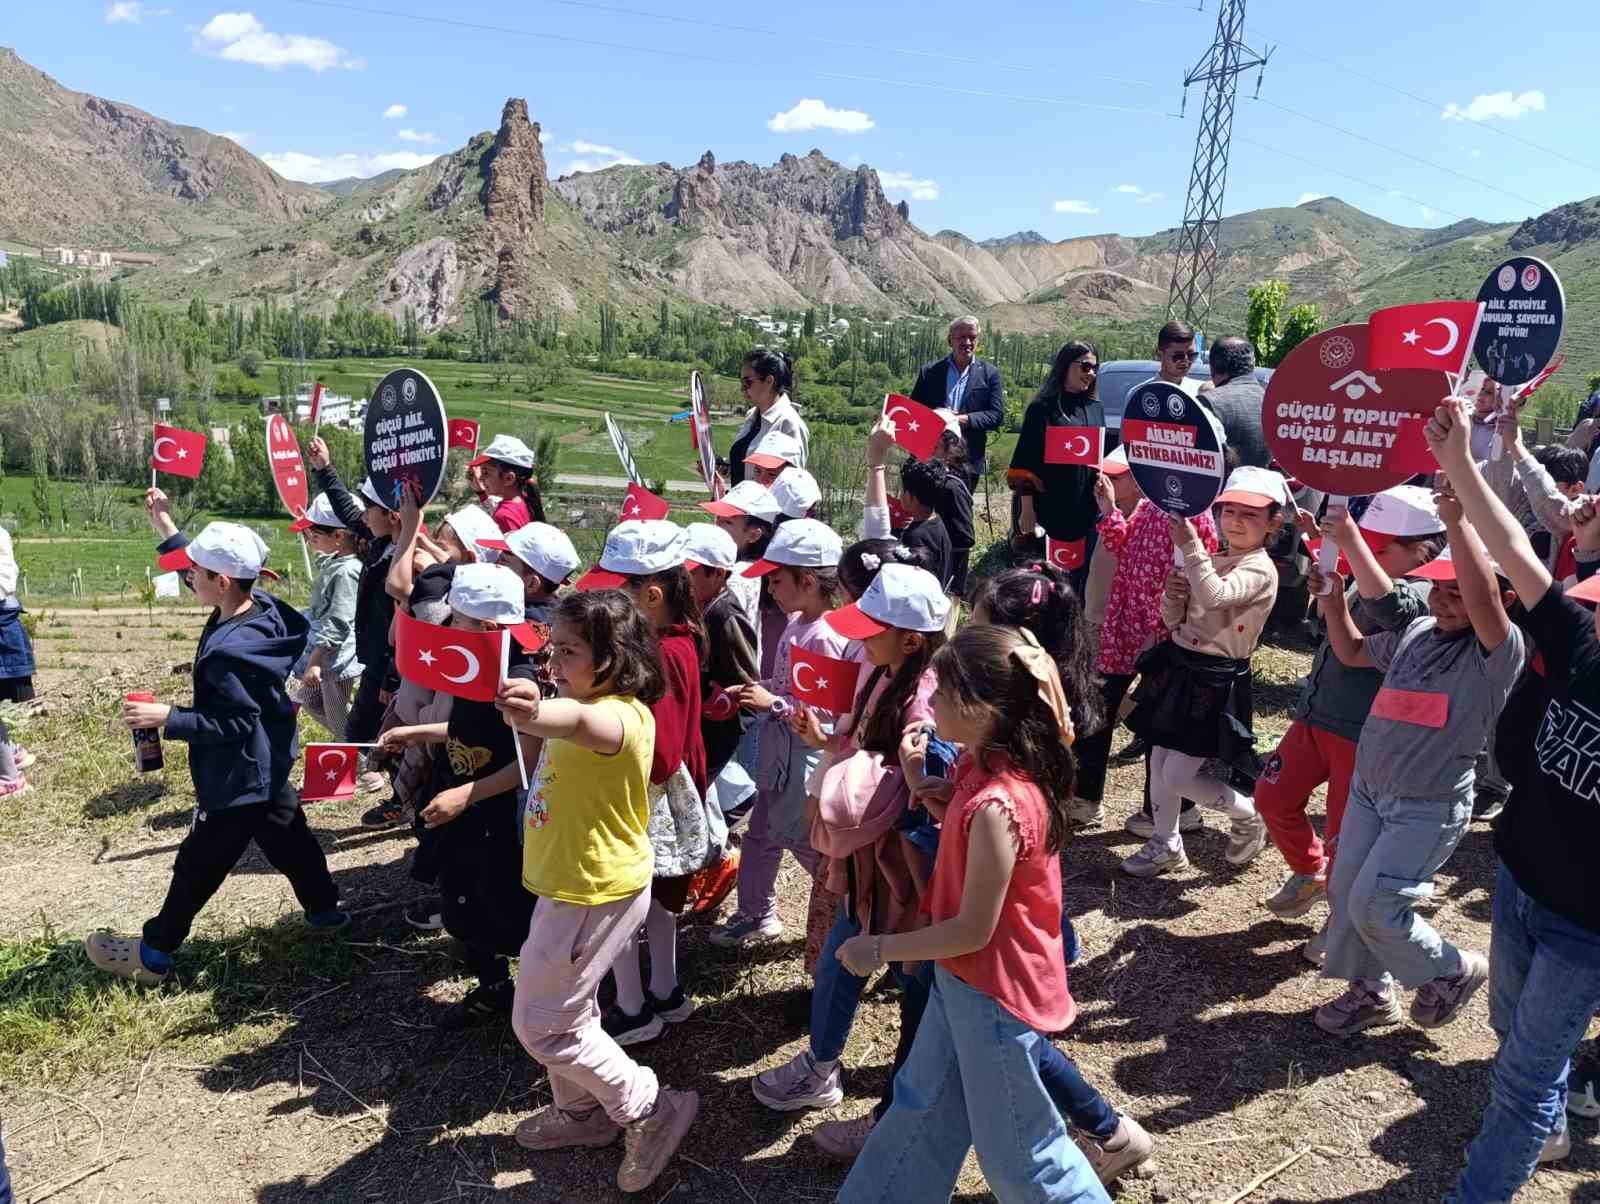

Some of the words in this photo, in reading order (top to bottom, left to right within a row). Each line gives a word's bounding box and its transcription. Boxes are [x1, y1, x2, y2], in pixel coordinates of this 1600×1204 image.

[1498, 324, 1529, 337] BÜYÜR!
[1276, 401, 1336, 425] GÜÇLÜ
[375, 414, 402, 436] GÜÇLÜ
[1146, 424, 1195, 447] AİLEMİZ
[1277, 422, 1337, 446] GÜÇLÜ
[1342, 427, 1397, 449] AİLEY
[371, 435, 398, 455] GÜÇLÜ
[371, 452, 398, 473] GÜÇLÜ
[1131, 443, 1216, 470] İSTİKBALİMİZ!
[1302, 447, 1383, 469] BAŞLAR!
